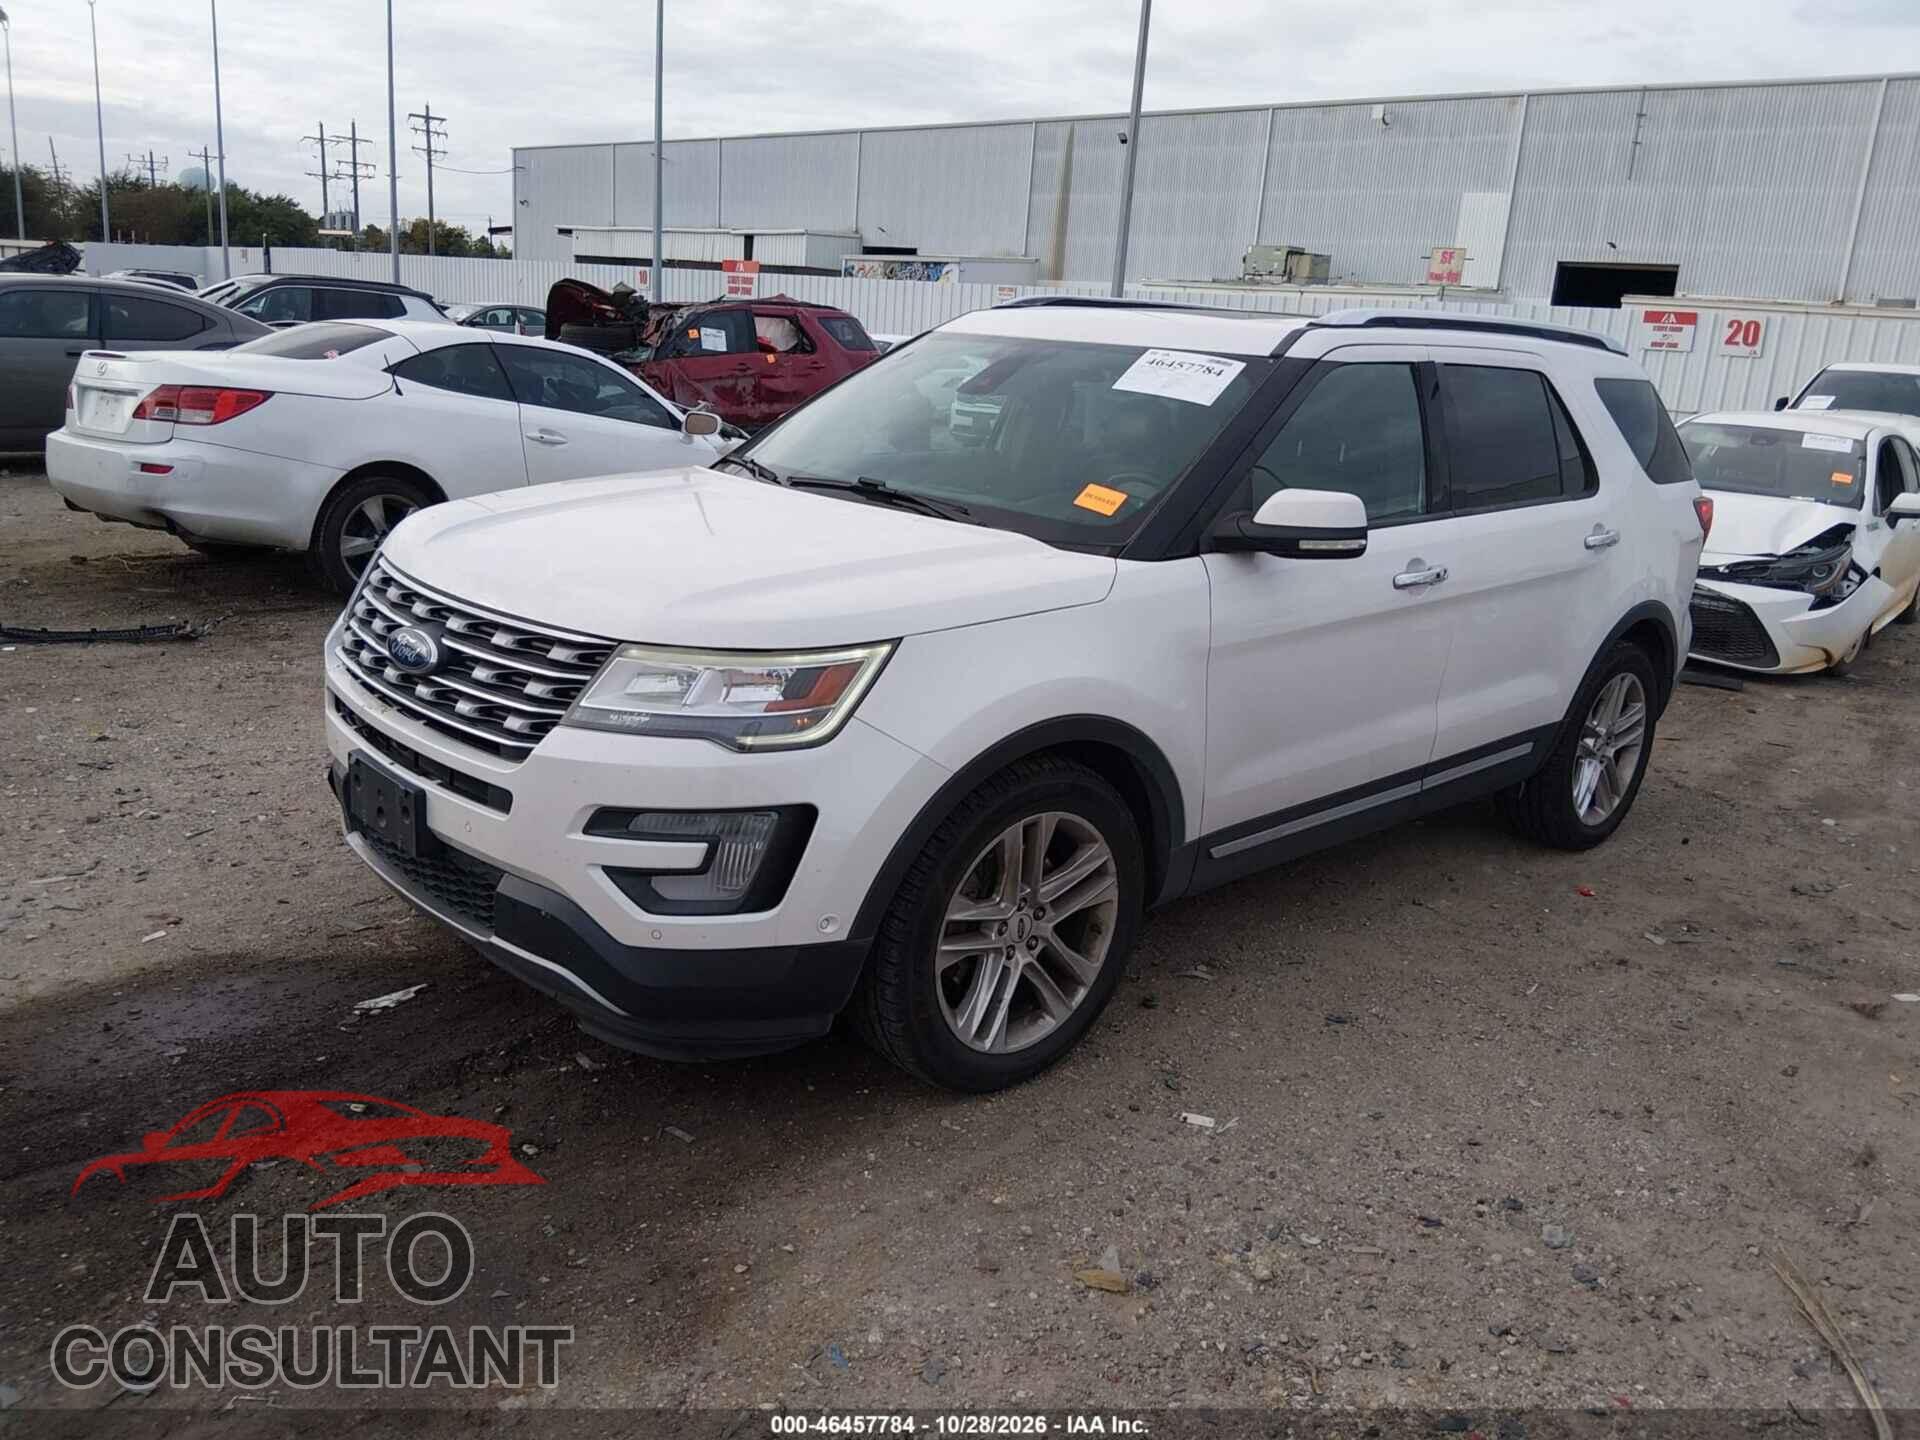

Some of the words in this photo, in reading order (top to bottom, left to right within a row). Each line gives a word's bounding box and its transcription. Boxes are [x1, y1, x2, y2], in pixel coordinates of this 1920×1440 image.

[1440, 250, 1456, 264] SF
[639, 270, 648, 285] 10
[1724, 319, 1761, 347] 20
[1145, 359, 1225, 377] 46457784
[391, 633, 421, 663] Ford
